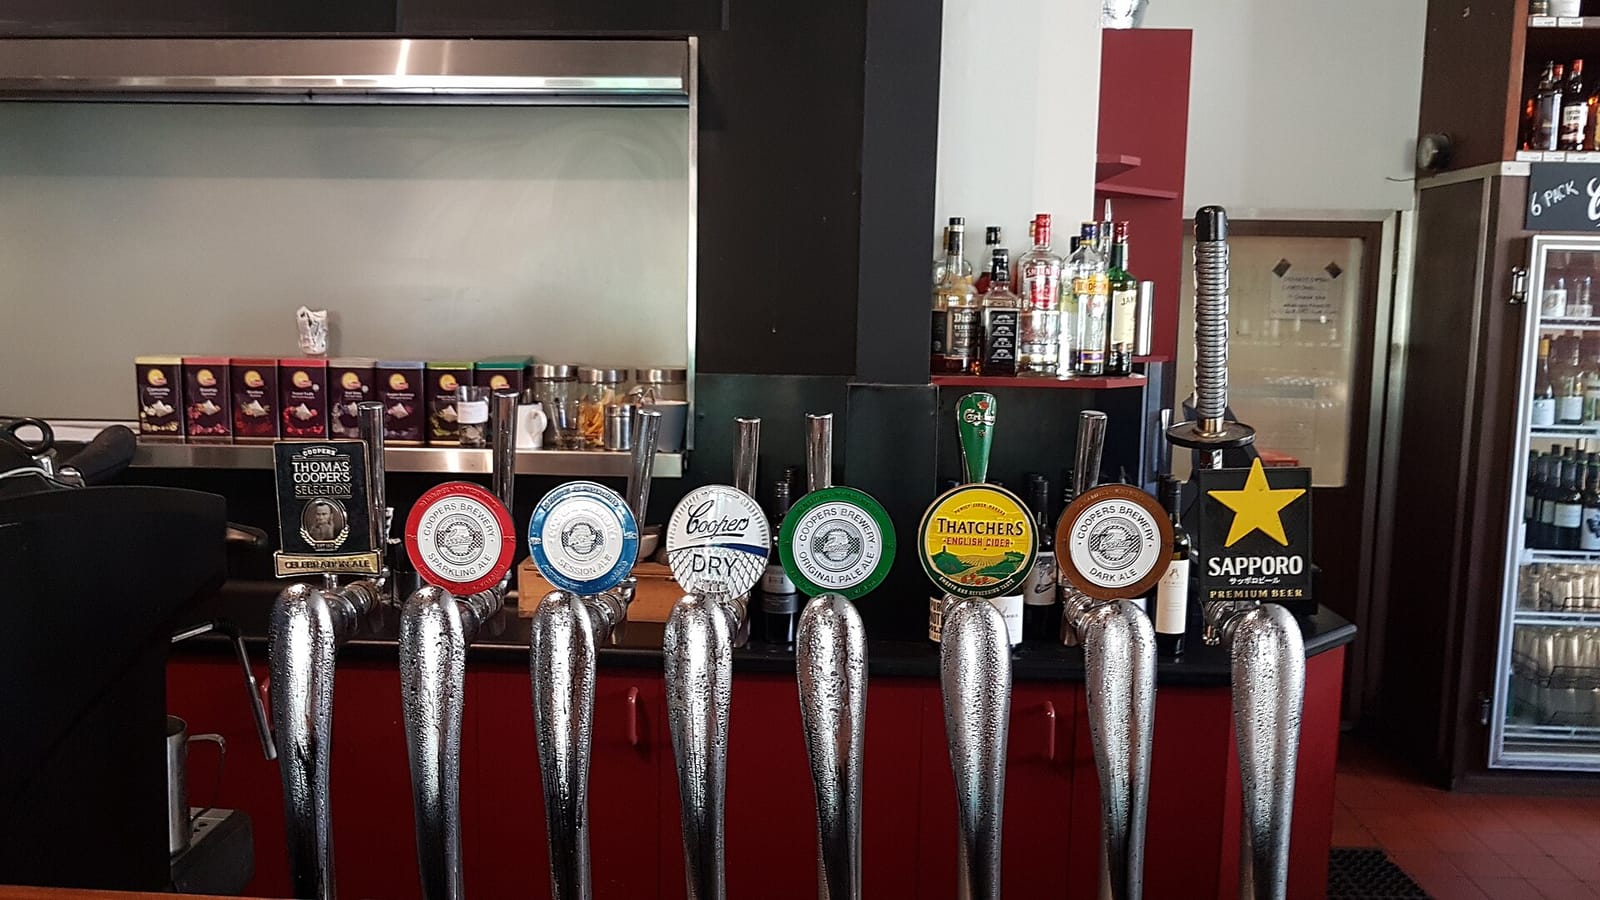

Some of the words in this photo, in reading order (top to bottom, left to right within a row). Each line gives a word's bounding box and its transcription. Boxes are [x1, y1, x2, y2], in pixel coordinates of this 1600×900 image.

[1531, 192, 1542, 216] 6
[1543, 180, 1579, 207] PACK
[291, 461, 350, 473] THOMAS
[292, 472, 351, 483] COOPER'S
[294, 485, 351, 496] SELECTION
[424, 502, 457, 537] COOPERS
[460, 502, 495, 540] BREWERY
[686, 499, 749, 539] Coopers
[799, 507, 837, 542] COOPERS
[840, 508, 876, 544] BREWERY
[937, 518, 1024, 536] THATCHERS
[1077, 505, 1116, 539] COOPERS
[1119, 505, 1155, 542] BREWERY
[946, 537, 983, 546] ENGLISH
[986, 538, 1010, 548] CIDER
[352, 559, 371, 568] ALE
[427, 552, 477, 577] SPARKLING
[478, 554, 492, 571] ALE
[558, 558, 597, 576] SESSION
[598, 553, 613, 570] ALE
[692, 553, 740, 577] DRY
[799, 551, 836, 584] ORIGINAL
[839, 568, 863, 583] PALE
[863, 551, 875, 570] ALE
[1089, 567, 1116, 582] DARK
[1119, 568, 1138, 581] ALE
[1208, 555, 1303, 576] SAPPORO
[1209, 589, 1268, 599] PREMIUM
[1271, 589, 1303, 598] BEER
